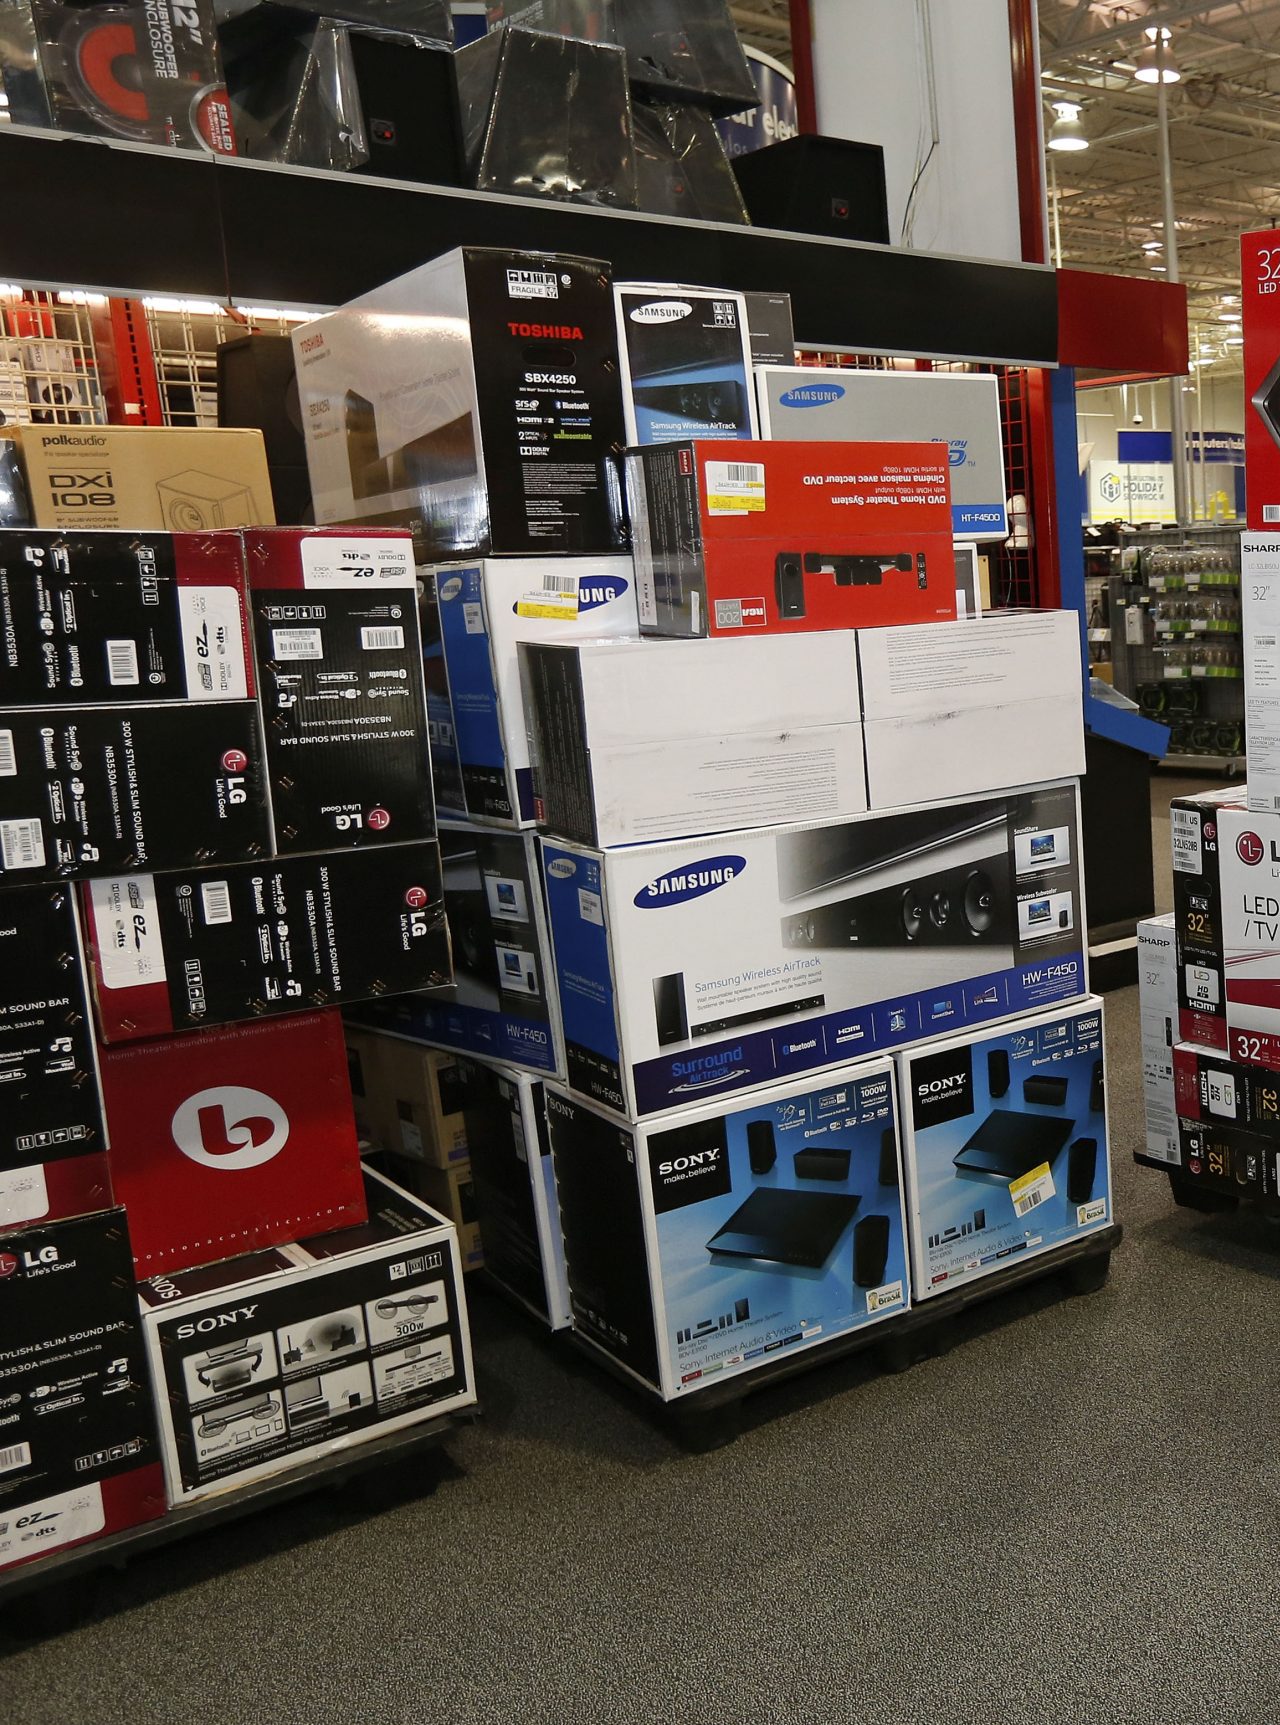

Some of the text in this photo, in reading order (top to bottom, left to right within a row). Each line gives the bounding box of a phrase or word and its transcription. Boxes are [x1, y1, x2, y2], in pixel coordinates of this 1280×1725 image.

[144, 0, 168, 79] NCLOSURE
[158, 0, 179, 79] UBWOOFER
[511, 285, 544, 295] FRAGILE
[1258, 282, 1277, 294] LED
[638, 307, 686, 318] SAMSUNG
[508, 322, 584, 341] TOSHIBA
[524, 372, 577, 385] SBX4250
[788, 390, 838, 401] SAMSUNG
[650, 421, 737, 431] Samsung Wireless AirTrack
[42, 434, 106, 448] polkaudio
[48, 471, 113, 488] DXi
[803, 474, 945, 485] Cinéma maison avec lecteur DVD
[1123, 482, 1164, 493] HOLIDAY
[832, 496, 946, 506] DVD Home Theater System
[962, 513, 1000, 522] HT-F4500
[719, 612, 739, 624] 200
[217, 627, 225, 643] dts
[6, 624, 19, 668] NB3530A
[354, 716, 392, 725] NB3530A
[280, 731, 390, 746] STYLISH SLIM SOUND BAR
[105, 746, 117, 786] NB3530A
[126, 748, 145, 841] STYLISH SOUND
[217, 798, 227, 818] Good
[321, 803, 362, 814] Life's Good
[336, 813, 363, 830] LG
[1013, 825, 1039, 835] SoundShare
[1173, 838, 1198, 852] 32LN520B
[648, 867, 734, 897] SAMSUNG
[1016, 887, 1058, 901] Wireless Subwoofer
[1243, 894, 1280, 917] LED
[1188, 912, 1209, 934] 32"
[1253, 920, 1279, 942] TV
[322, 891, 342, 992] STYLISH SOUND BAR
[1138, 935, 1170, 947] SHARP
[694, 956, 822, 993] Samsung Wireless AirTrack
[1022, 961, 1078, 986] HW-F450
[1188, 1000, 1216, 1012] HDMI
[507, 1023, 547, 1045] HW-F450
[837, 1024, 861, 1035] HDMI
[1077, 1020, 1099, 1032] 1000W
[789, 1038, 817, 1053] Bluetooth
[1237, 1035, 1269, 1061] 32"
[671, 1046, 744, 1078] Surround
[860, 1083, 887, 1098] 1000W
[918, 1073, 967, 1096] SONY
[921, 1087, 964, 1105] make.believe
[549, 1098, 575, 1120] SONY
[658, 1148, 721, 1175] SONY
[664, 1163, 717, 1185] make.believe
[24, 1245, 60, 1268] LG
[27, 1260, 77, 1279] Life's Good
[878, 1293, 902, 1306] Brasil
[177, 1304, 259, 1340] SONY
[43, 1326, 104, 1350] SLIM SOUND
[705, 1323, 797, 1364] Internet Audio Video
[36, 1526, 57, 1537] dts
